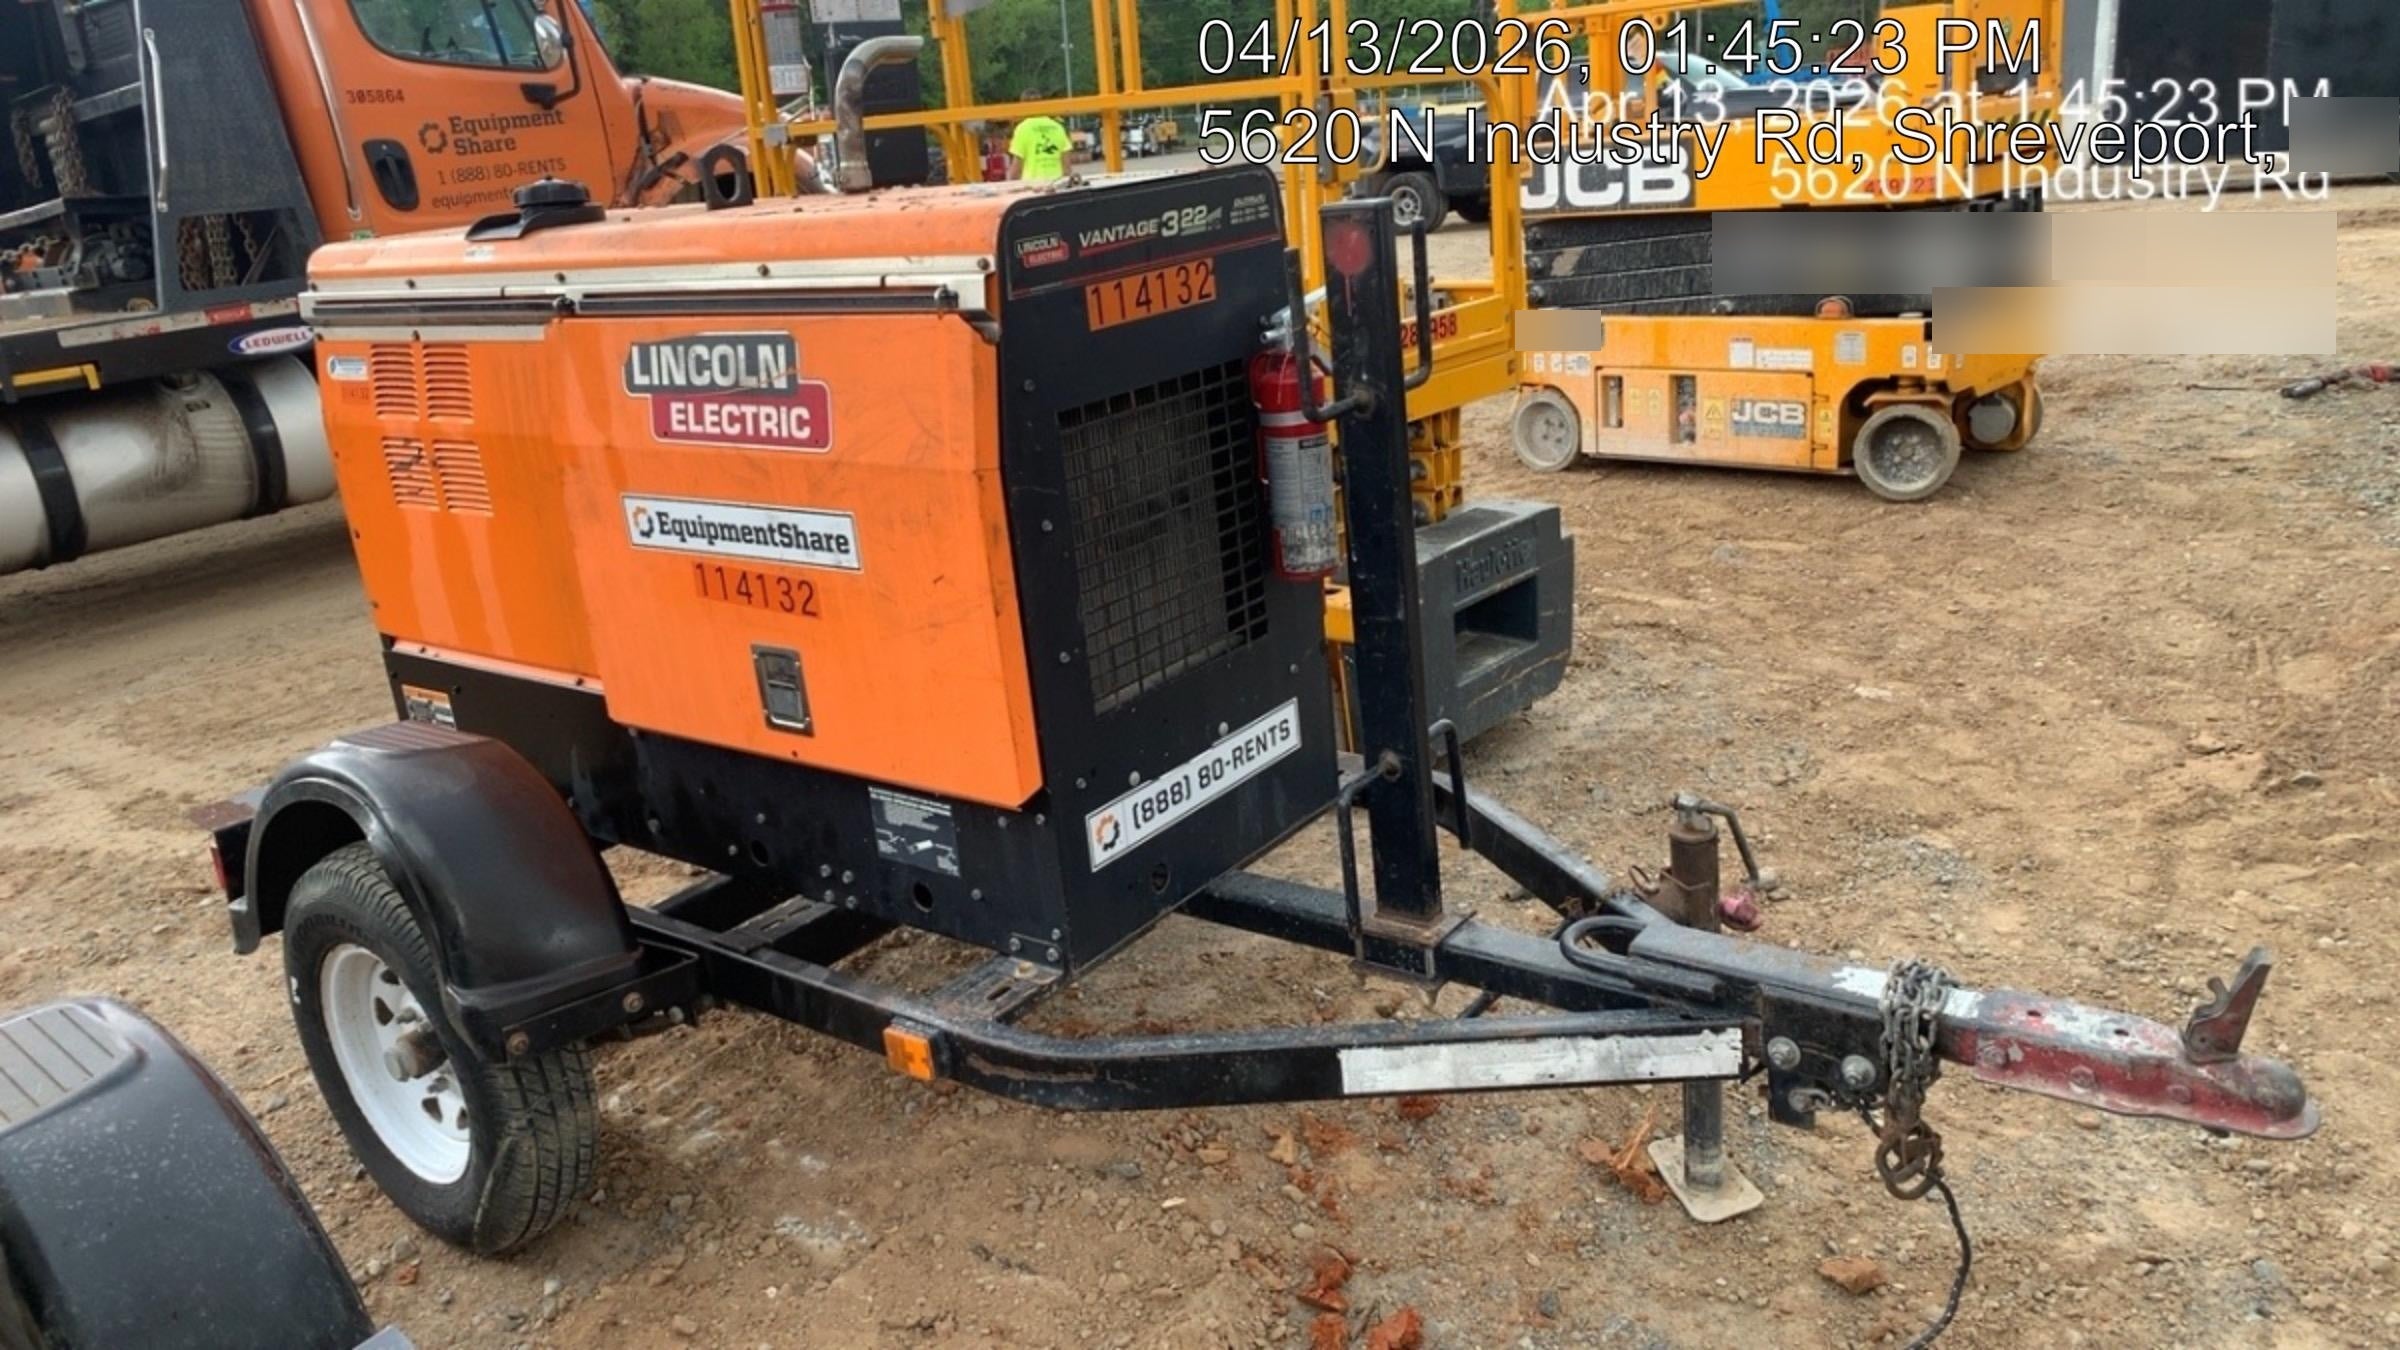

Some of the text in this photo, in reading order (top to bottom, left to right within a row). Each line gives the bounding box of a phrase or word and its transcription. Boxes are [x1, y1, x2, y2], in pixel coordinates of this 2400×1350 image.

[346, 89, 405, 104] 305864
[448, 109, 565, 137] Equipment
[453, 136, 518, 157] Share
[438, 158, 566, 185] 1 (888) 80-RENTS
[1520, 144, 1691, 210] JCB
[1079, 218, 1160, 248] VANTAGE
[1161, 205, 1208, 237] 322
[1017, 237, 1060, 257] LINCOLN
[1091, 261, 1214, 325] 114132
[244, 331, 308, 349] LEDWELL
[631, 343, 788, 389] LINCOLN
[669, 401, 811, 440] ELECTRIC
[1732, 399, 1806, 425] JCB
[656, 511, 850, 554] EquipmentShare
[695, 562, 819, 618] 114132
[1132, 718, 1292, 830] (888) 80-RENTS
